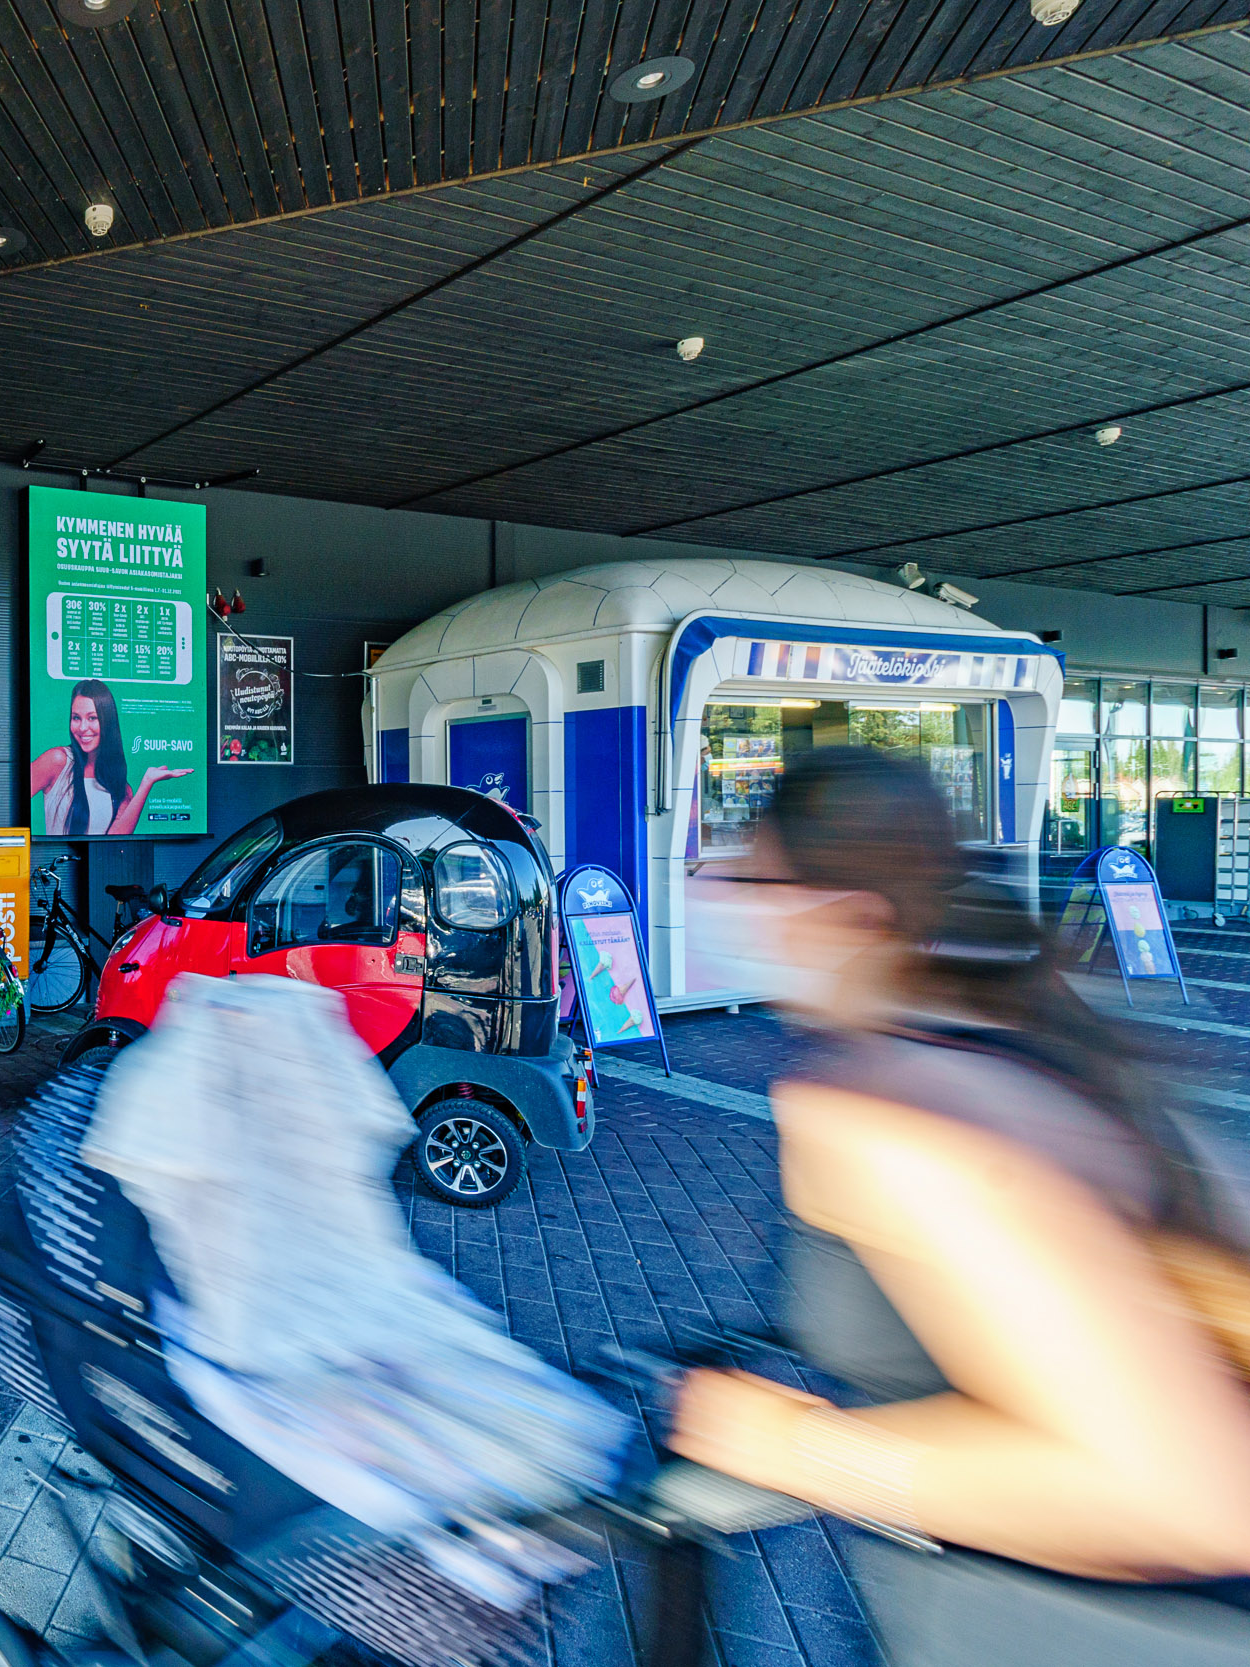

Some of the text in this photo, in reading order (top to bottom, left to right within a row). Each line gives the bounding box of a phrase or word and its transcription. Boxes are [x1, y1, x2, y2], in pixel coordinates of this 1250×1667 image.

[56, 515, 183, 543] KYMMENEN HYVÄÄ
[56, 537, 183, 568] SYYTÄ LIITTYÄ
[56, 563, 95, 573] OSUUSKAUPPA
[65, 599, 82, 610] 30€
[88, 601, 106, 611] 30%
[114, 603, 127, 613] 2 x
[136, 604, 149, 615] 2 x
[159, 606, 170, 616] 1 x
[67, 640, 80, 651] 2 x
[91, 642, 104, 652] 2 x
[112, 643, 129, 653] 30€
[135, 644, 151, 655] 15%
[156, 645, 174, 656] 20%
[847, 652, 946, 679] Jäätelökioski
[144, 739, 193, 752] SUUR-SAVO
